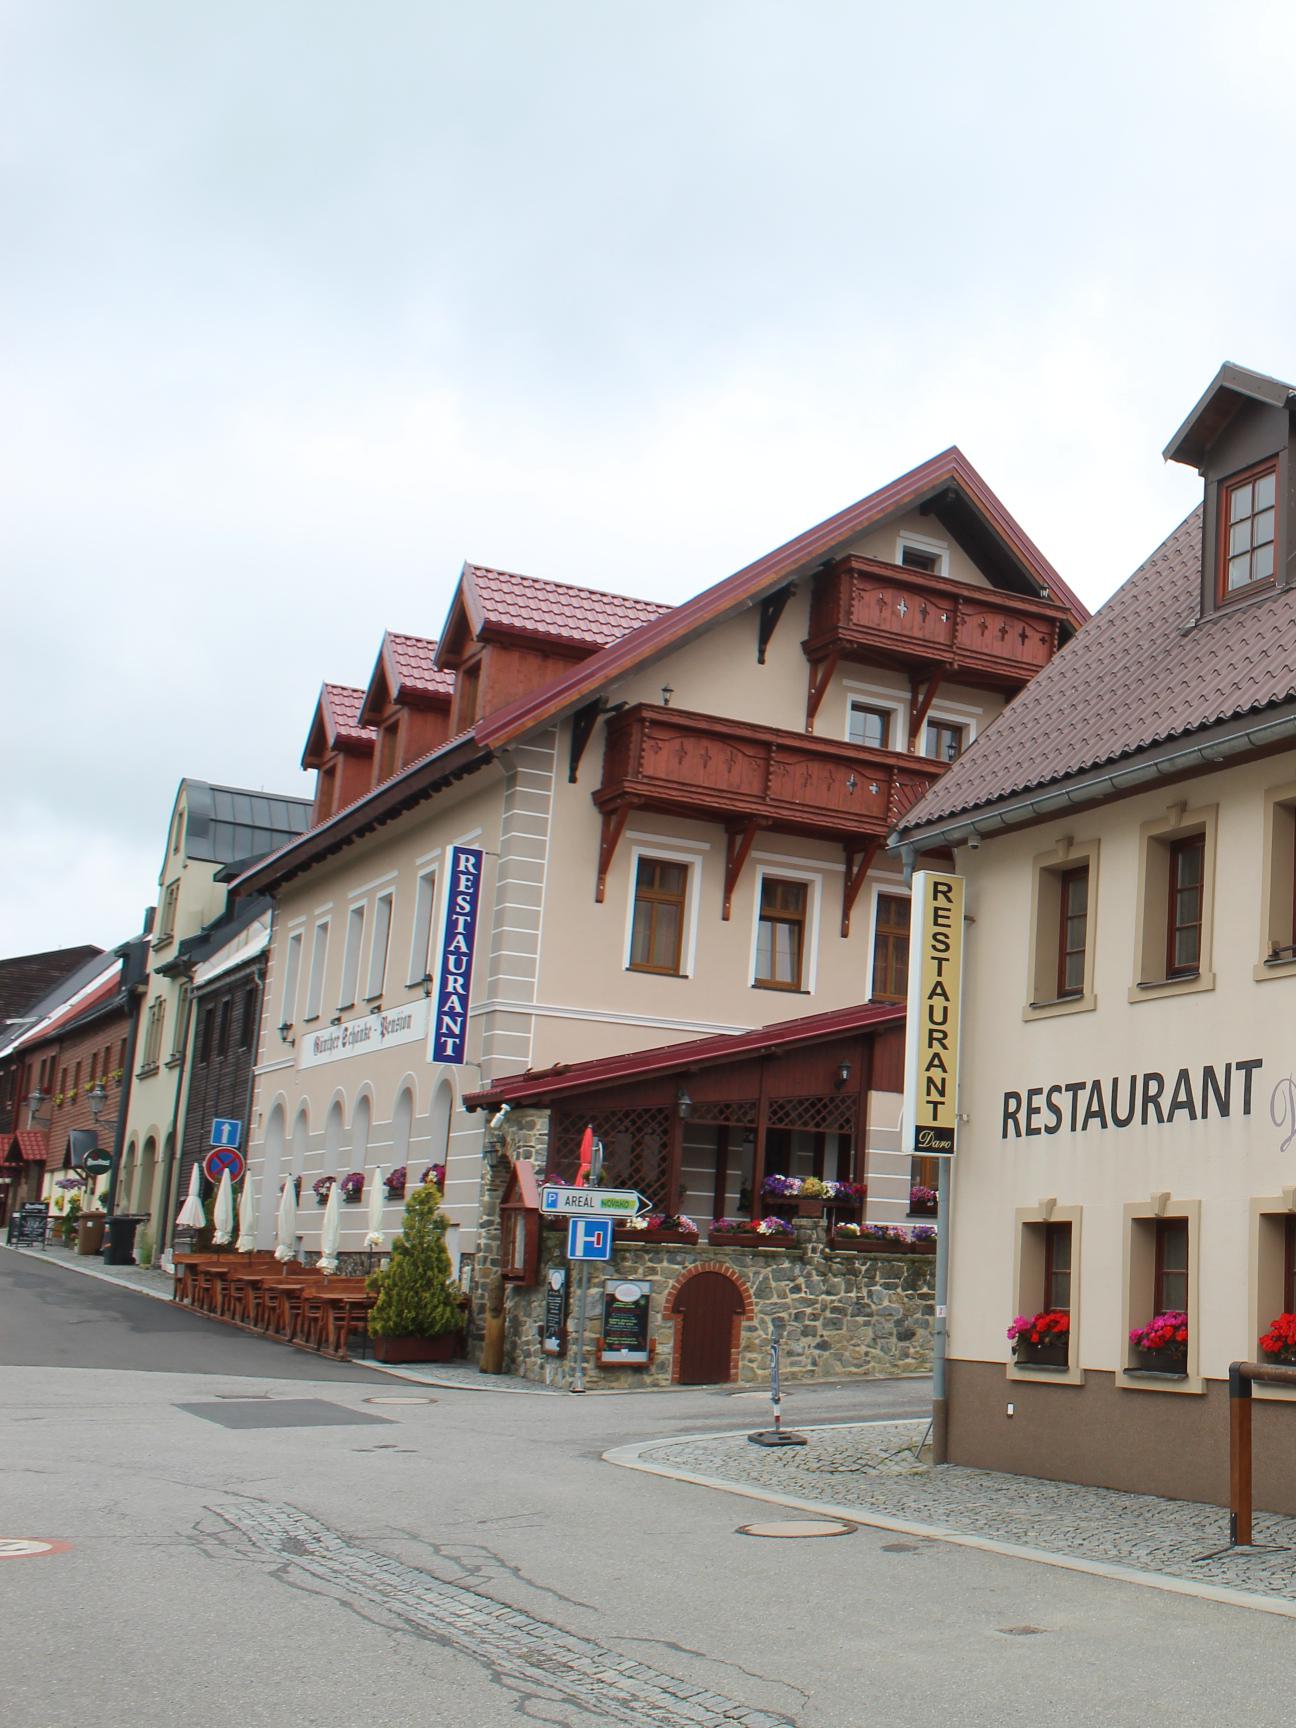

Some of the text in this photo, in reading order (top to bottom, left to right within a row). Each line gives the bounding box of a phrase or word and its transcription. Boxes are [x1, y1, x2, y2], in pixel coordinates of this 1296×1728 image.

[440, 853, 479, 1057] RESTAURANT
[380, 1011, 412, 1042] Pension
[924, 880, 954, 1122] RESTAURANT
[1001, 1058, 1264, 1140] RESTAURANT
[917, 1130, 953, 1149] Daro
[547, 1193, 557, 1204] P
[564, 1194, 596, 1208] AREÁL
